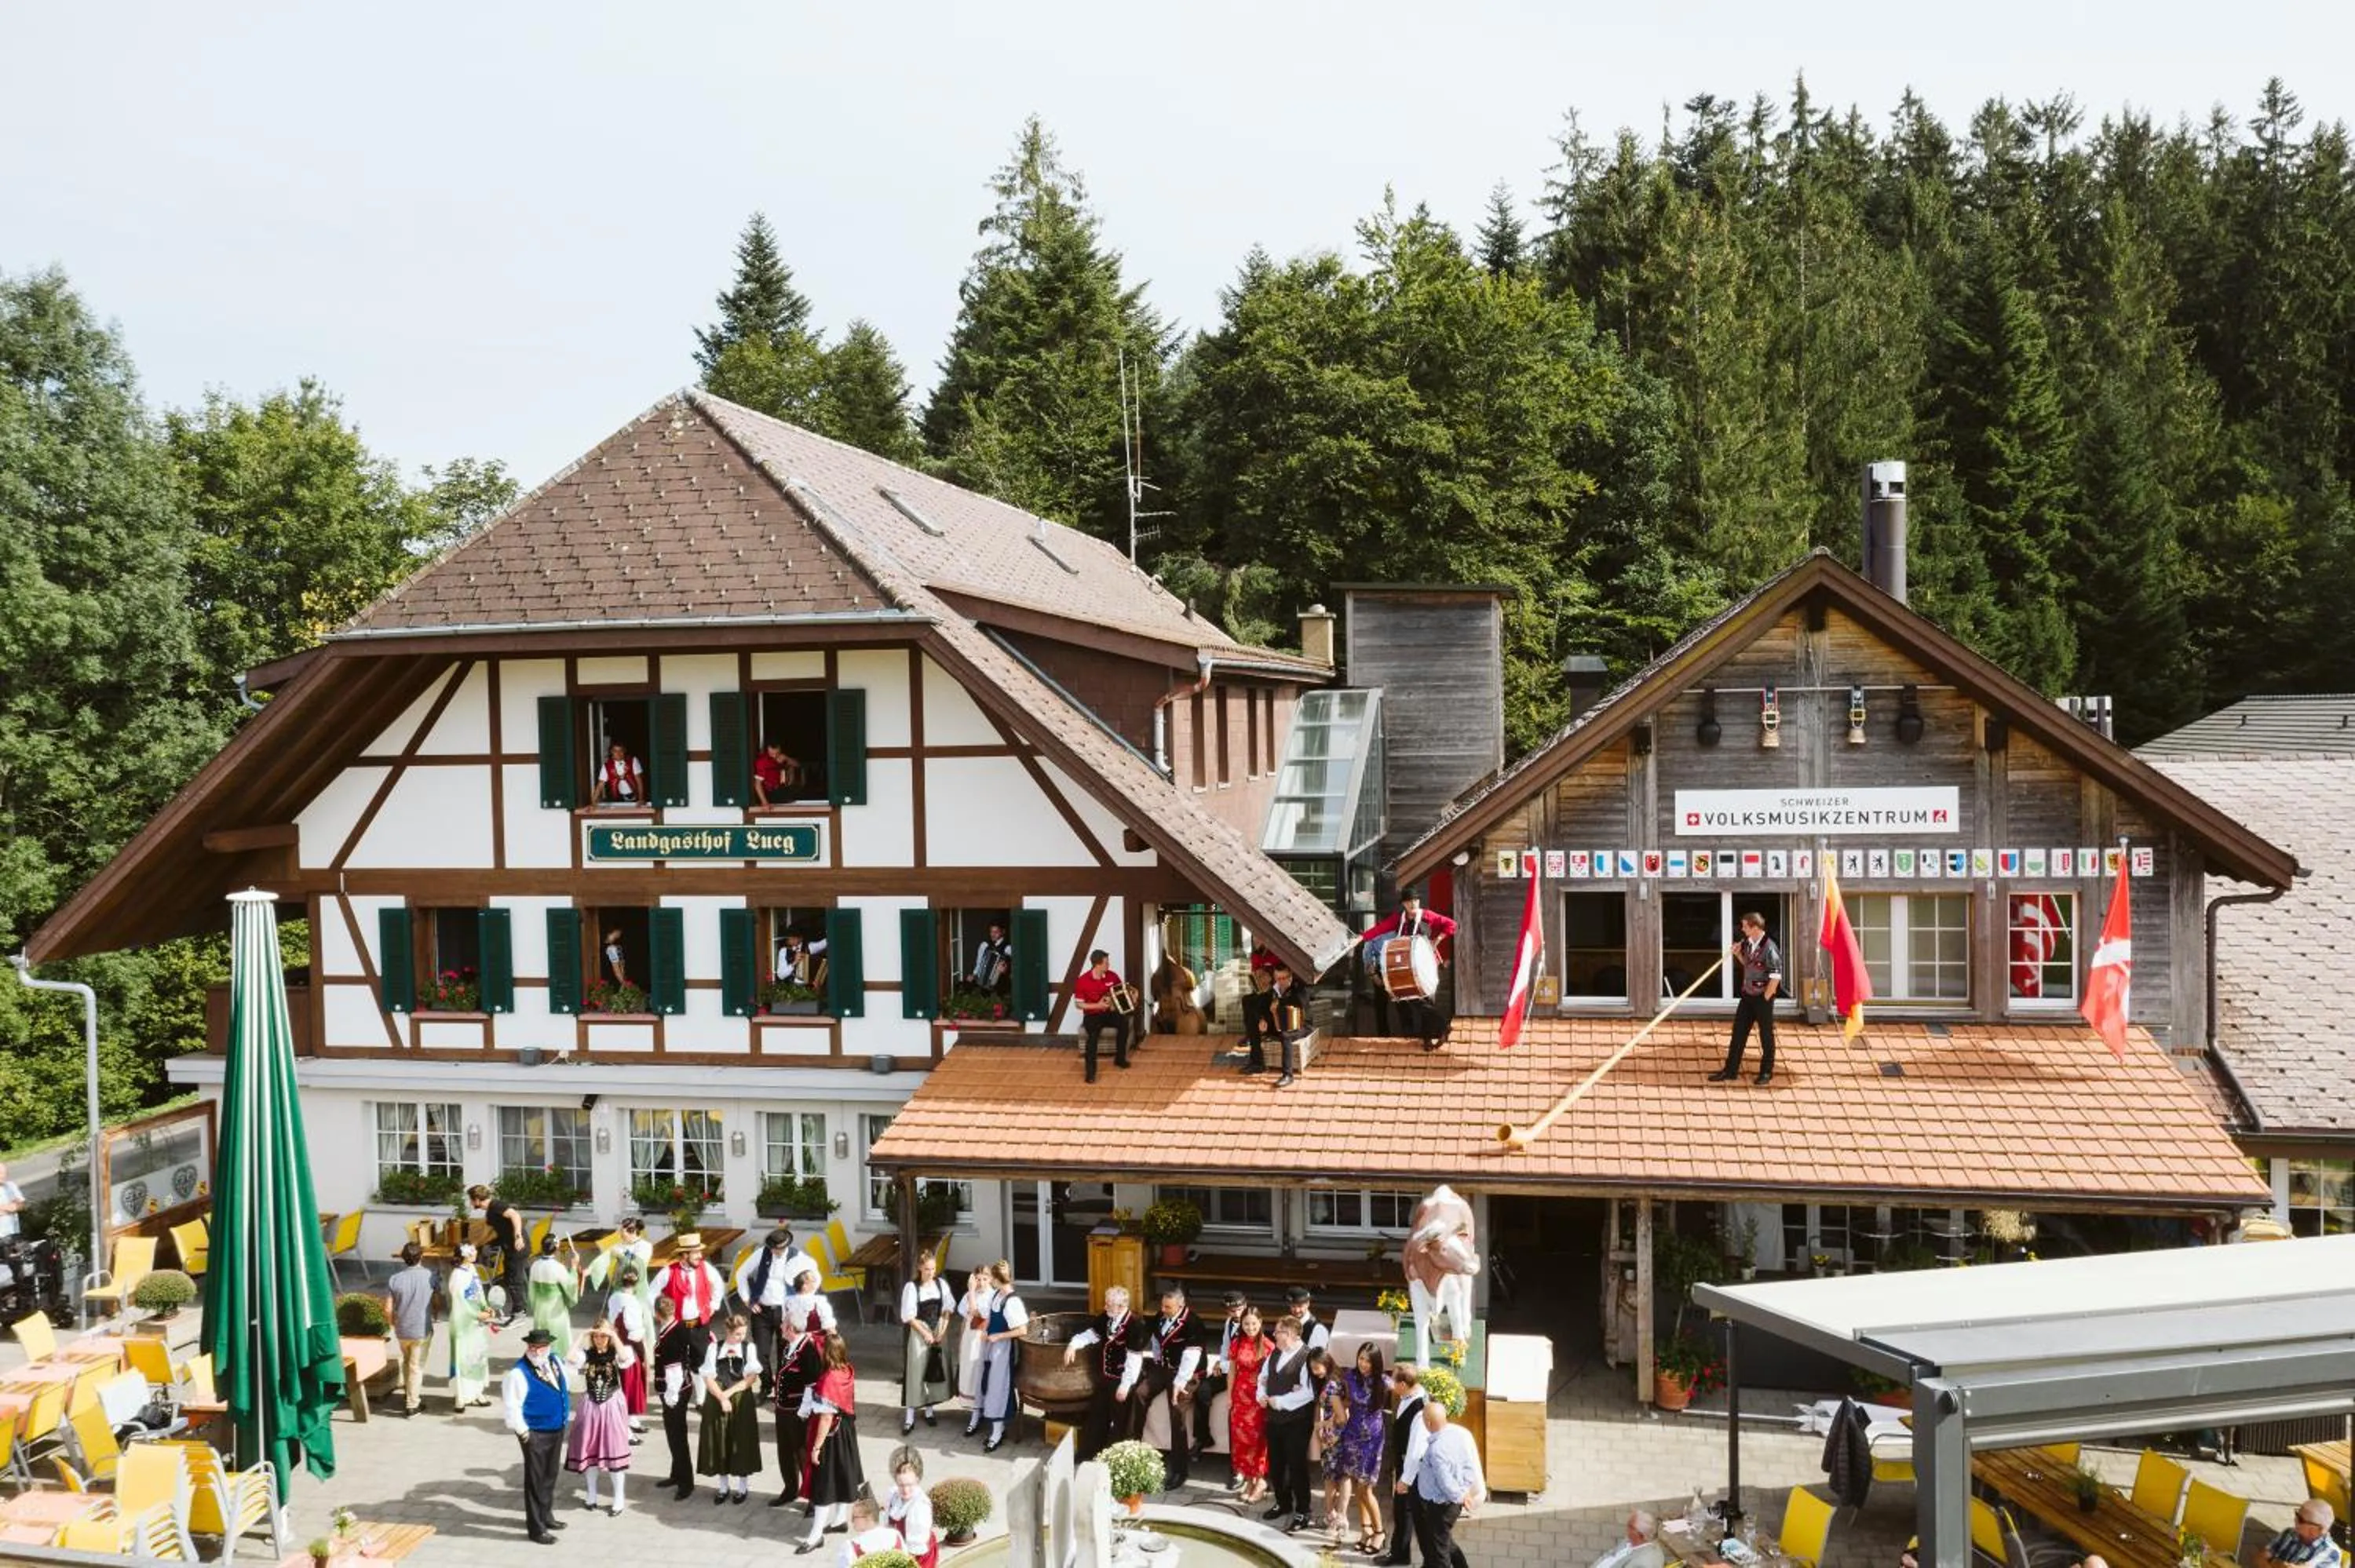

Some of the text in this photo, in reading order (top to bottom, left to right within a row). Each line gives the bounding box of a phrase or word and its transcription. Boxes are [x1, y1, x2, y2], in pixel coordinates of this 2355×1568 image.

[1780, 797, 1849, 807] SCHWEIZER
[1703, 810, 1927, 826] VOLKSMUSIKZENTRUM
[611, 830, 732, 855] Landgasthof
